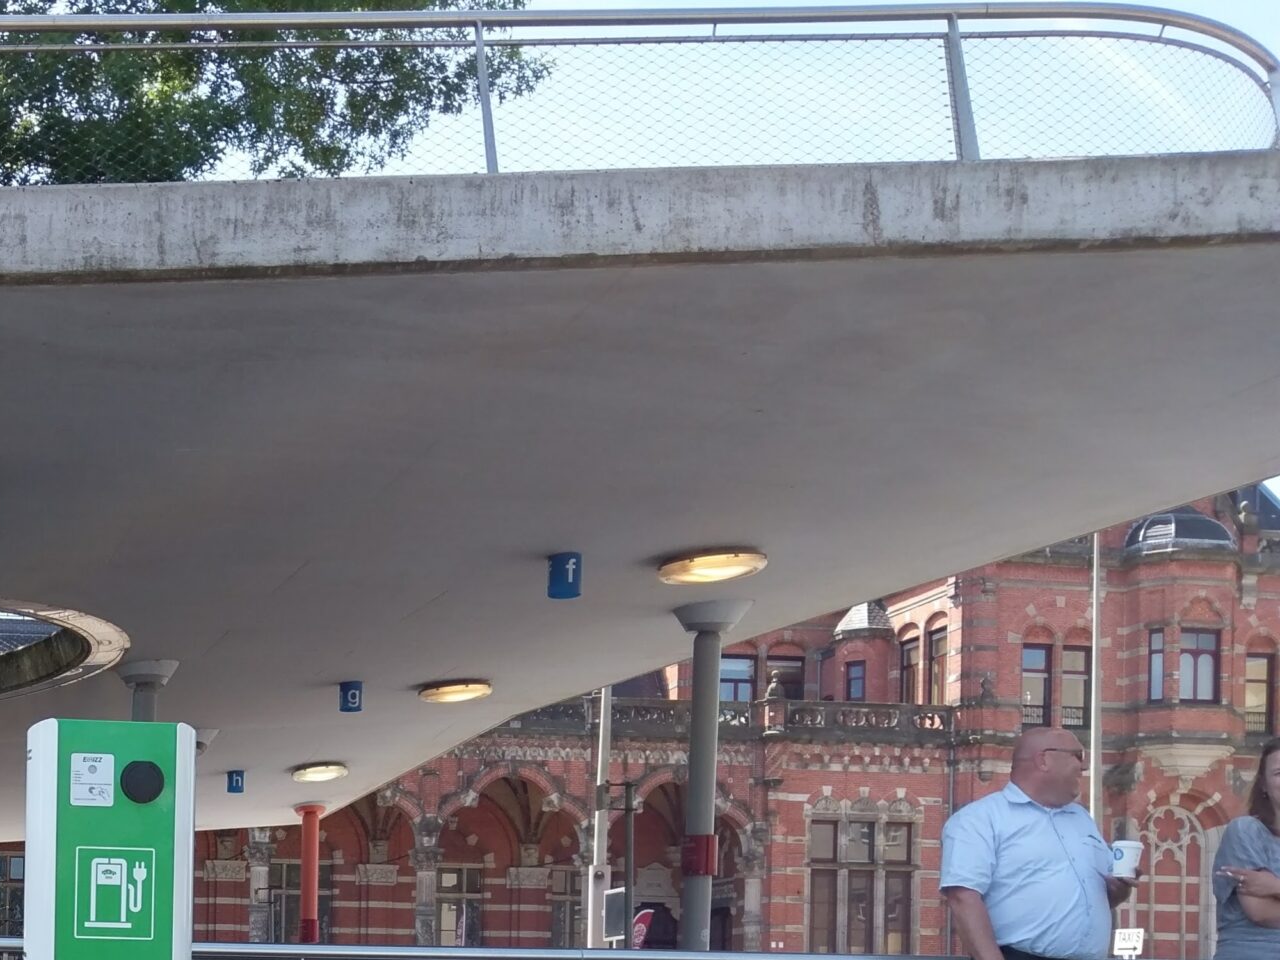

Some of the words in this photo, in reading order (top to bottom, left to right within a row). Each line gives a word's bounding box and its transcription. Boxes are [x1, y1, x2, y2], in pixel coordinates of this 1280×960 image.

[565, 558, 577, 583] f
[347, 686, 361, 707] g
[232, 773, 242, 787] h
